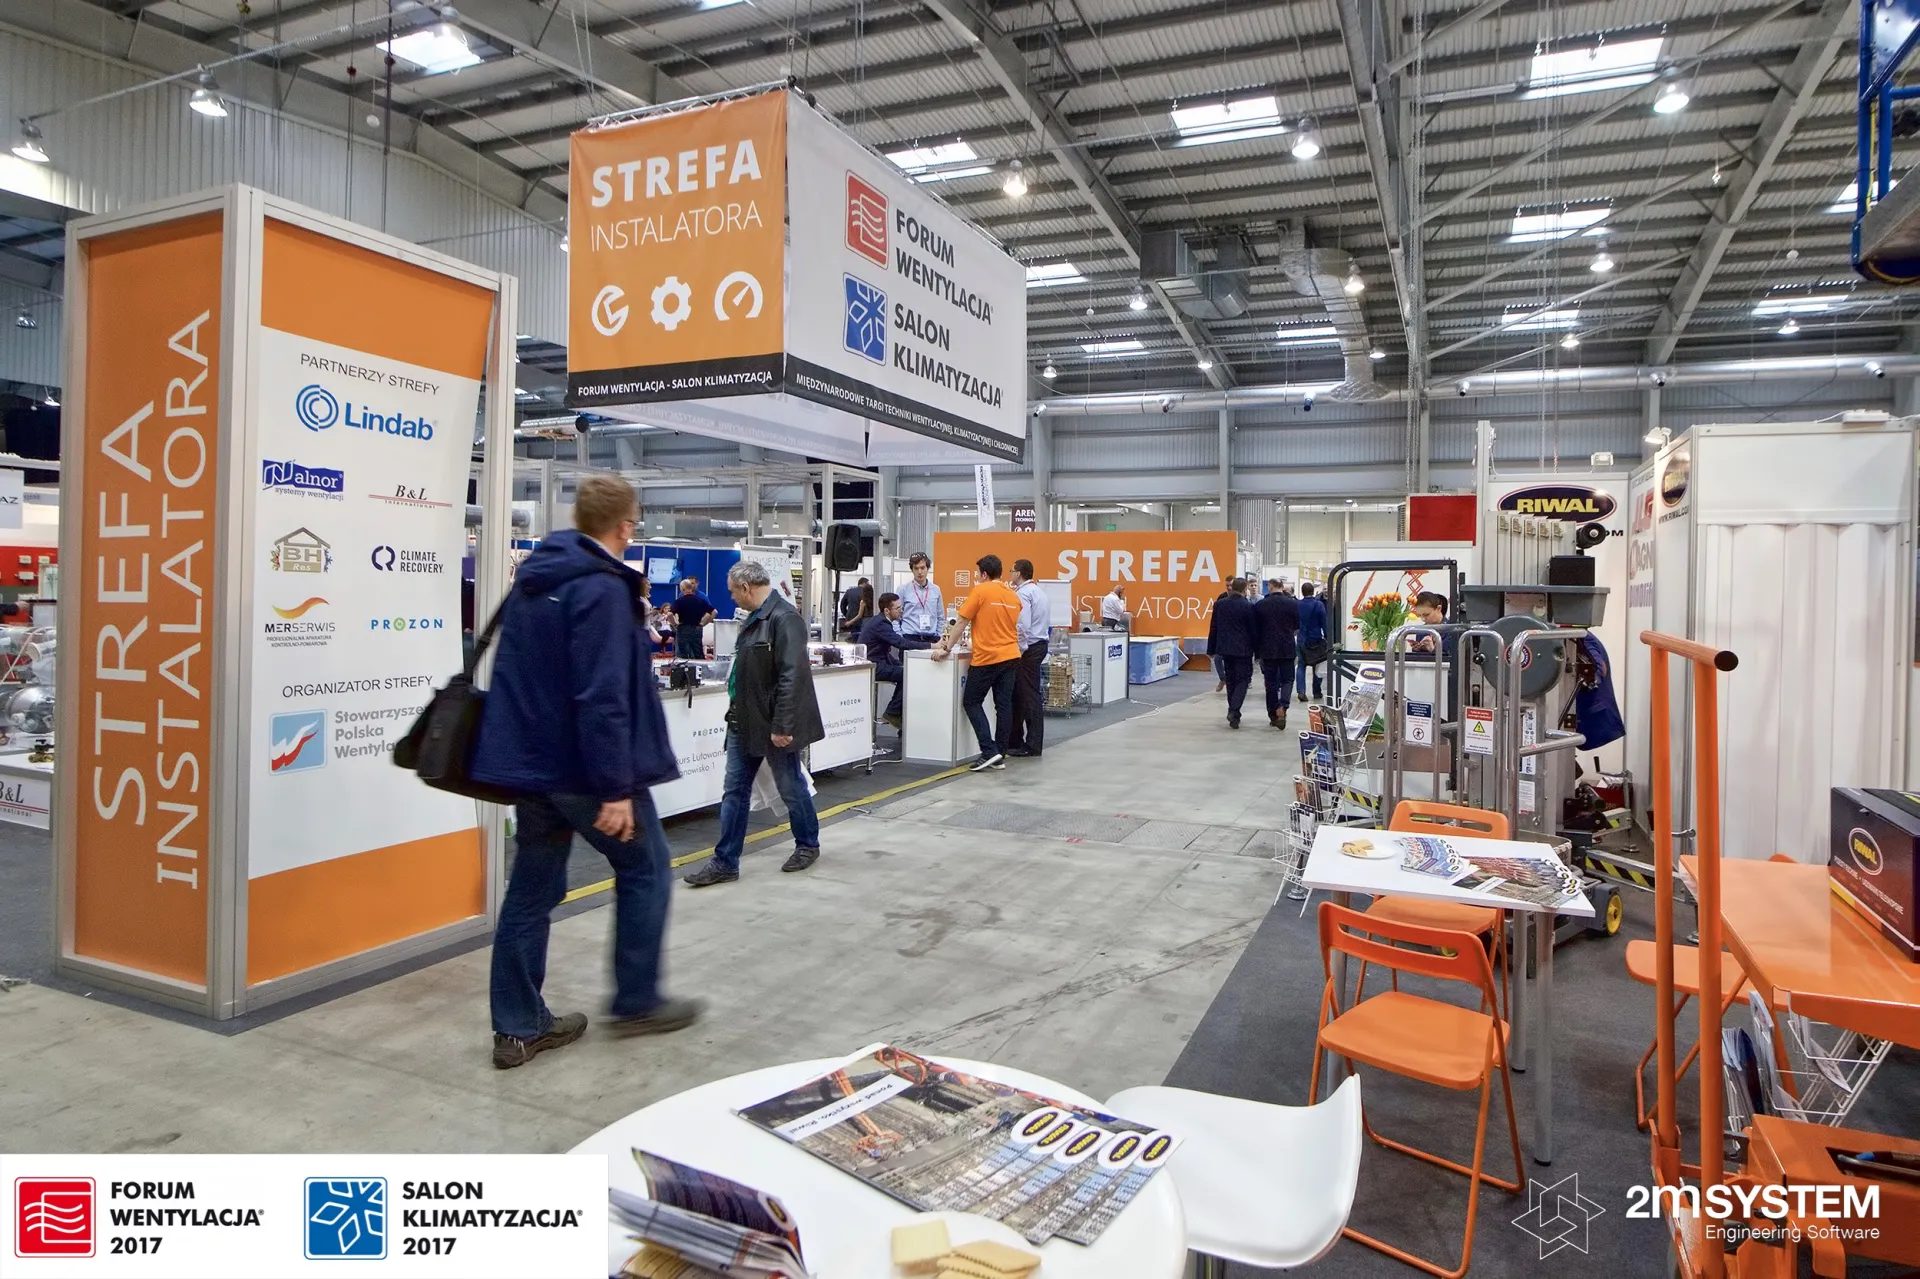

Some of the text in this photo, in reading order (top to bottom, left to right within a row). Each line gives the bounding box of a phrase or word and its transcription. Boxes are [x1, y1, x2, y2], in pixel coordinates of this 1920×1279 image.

[591, 139, 762, 207] STREFA
[590, 199, 763, 252] INSTALATORA
[896, 208, 955, 268] FORUM
[894, 302, 950, 351] SALON
[300, 353, 440, 396] PARTNERZY STREFY
[578, 384, 608, 396] FORUM
[610, 379, 665, 394] WENTYLACJA
[672, 377, 702, 389] SALON
[704, 370, 772, 387] KLIMATYZACJA
[796, 373, 864, 405] MIĘDZYNARODOWE
[866, 397, 884, 411] TARGI
[885, 403, 911, 421] TECHNIKI
[275, 486, 344, 501] systemy wentylacji
[1517, 498, 1600, 513] RIWAL
[284, 548, 321, 562] BH
[400, 551, 436, 562] CLIMATE
[1057, 549, 1221, 583] STREFA
[292, 564, 312, 572] Res
[156, 308, 211, 889] INSTALATORA
[93, 400, 154, 826] STREFA
[371, 617, 443, 631] PROZON
[264, 622, 336, 633] MERSERWIS
[282, 675, 433, 699] ORGANIZATOR STREFY
[334, 705, 427, 724] Stowarzysze
[335, 725, 385, 741] Polska
[693, 727, 725, 737] PROZON
[334, 740, 397, 759] Wentyla
[680, 763, 710, 777] anowisko
[1854, 838, 1877, 865] RIWAL
[1026, 1113, 1054, 1134] RIWAL
[1041, 1123, 1069, 1145] RIWAL
[1068, 1132, 1096, 1154] RIWAL
[1112, 1137, 1137, 1160] RIWAL
[1145, 1137, 1168, 1160] RIWAL
